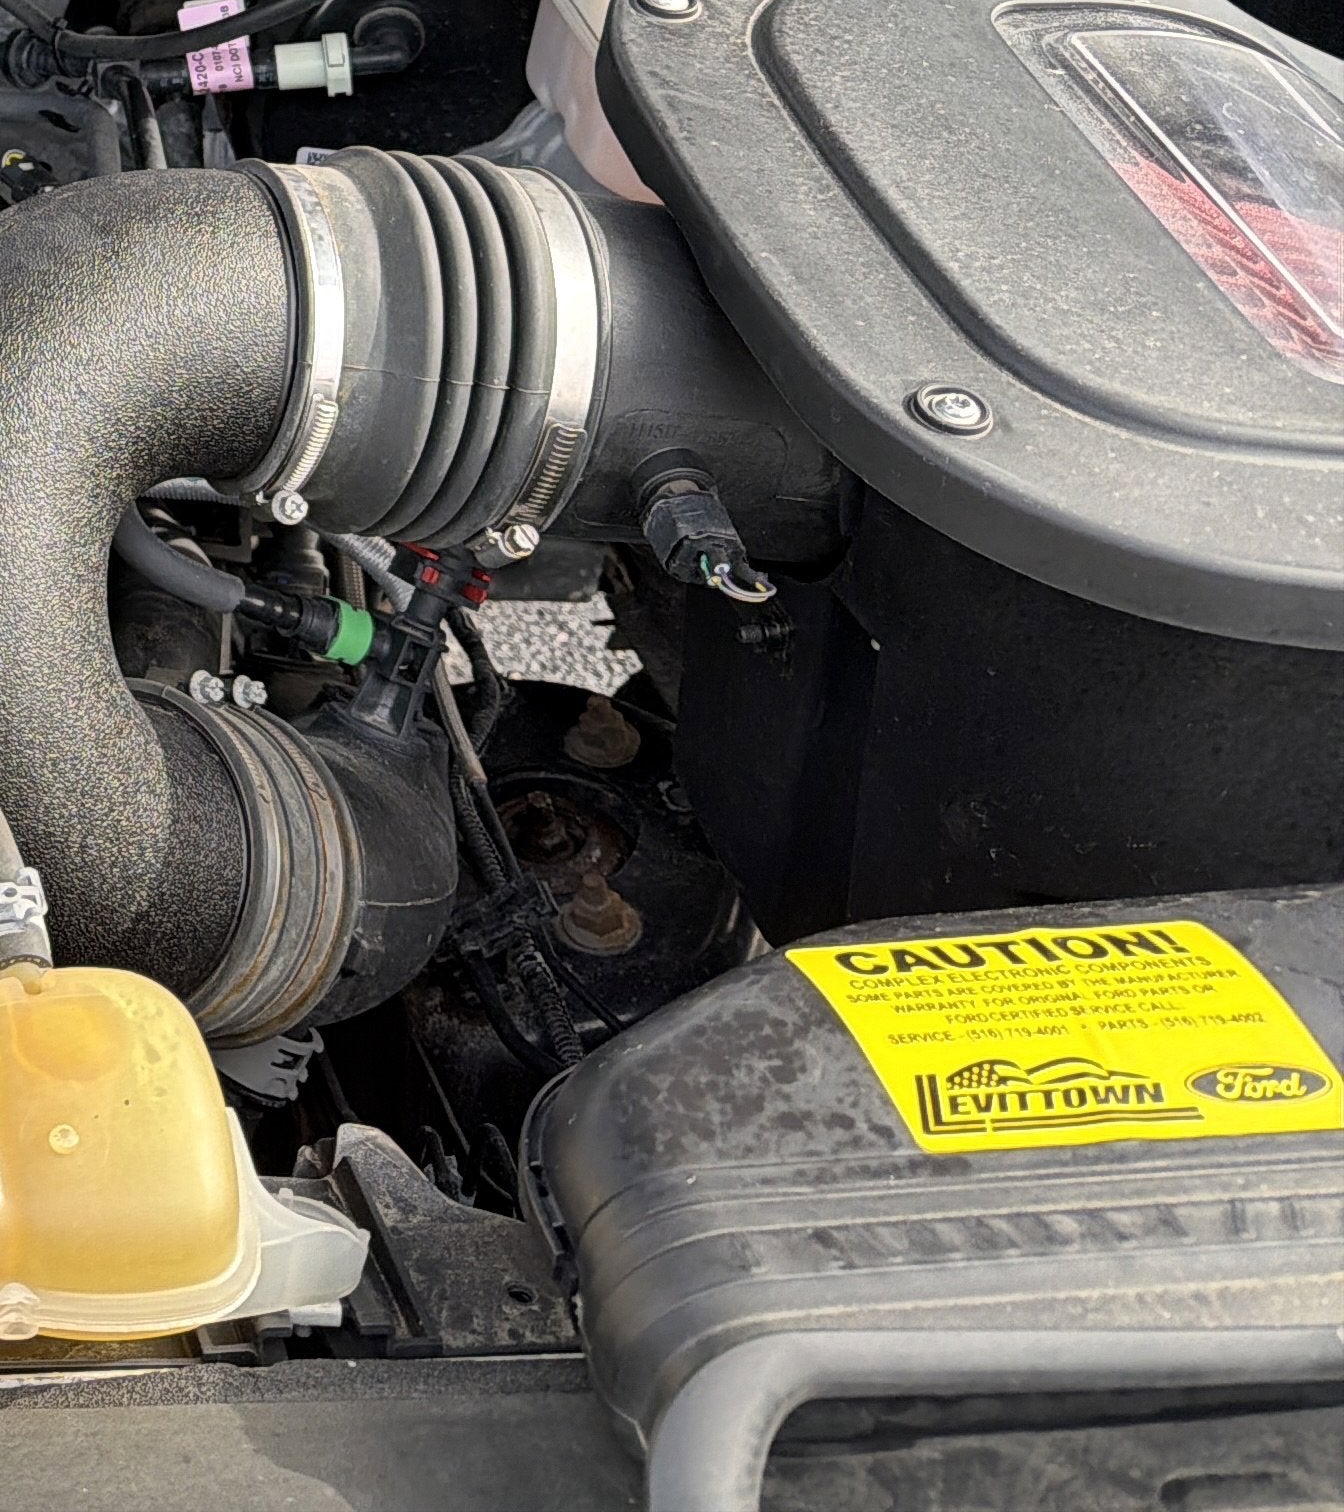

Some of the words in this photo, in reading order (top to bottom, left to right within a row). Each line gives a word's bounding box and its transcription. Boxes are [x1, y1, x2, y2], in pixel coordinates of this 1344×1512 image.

[834, 929, 1190, 975] CAUTION!
[849, 974, 945, 990] COMPLEX
[947, 964, 1072, 984] ELECTRONIC
[1075, 955, 1212, 975] COMPONENTS
[846, 993, 892, 1004] SOME
[893, 988, 946, 1001] PARTS
[947, 984, 979, 996] ARE
[982, 979, 1055, 995] COVERED
[1056, 979, 1077, 990] BY
[1083, 977, 1110, 988] THE
[892, 999, 979, 1014] WARRANTY
[983, 996, 1016, 1008] FOR
[1093, 988, 1138, 1000] FORD
[1140, 985, 1192, 998] PARTS
[887, 1030, 956, 1045] SERVICE
[1098, 1018, 1150, 1031] PARTS
[1215, 1067, 1309, 1099] Ford
